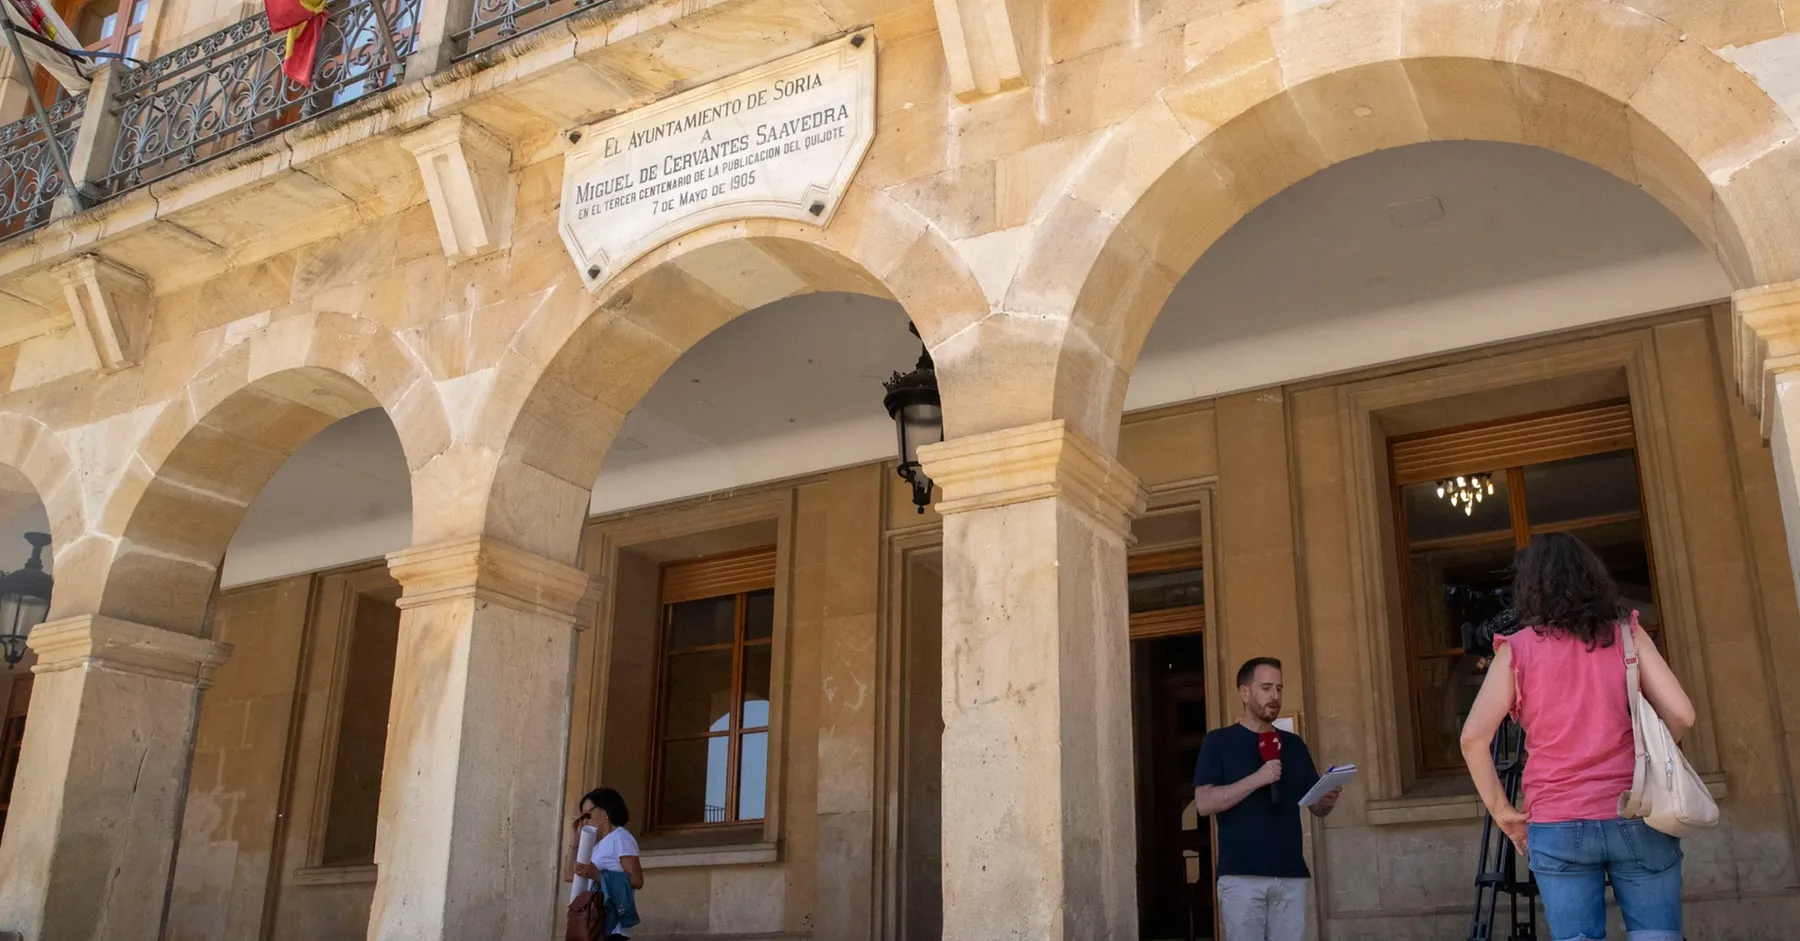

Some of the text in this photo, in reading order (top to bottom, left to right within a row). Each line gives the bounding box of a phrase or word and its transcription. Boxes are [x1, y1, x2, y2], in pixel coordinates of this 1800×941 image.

[576, 104, 849, 205] MIGUEL DE CERVANTES SAAVEDRA
[604, 73, 822, 158] EL AYUNTAMIENTO DE SORIA
[700, 130, 712, 144] A
[578, 126, 844, 220] EN EL TERCER CENTENARIO DE LA PUBLICACION DEL QUIJOTE
[653, 170, 756, 215] 7 DE MAYO DE 1905
